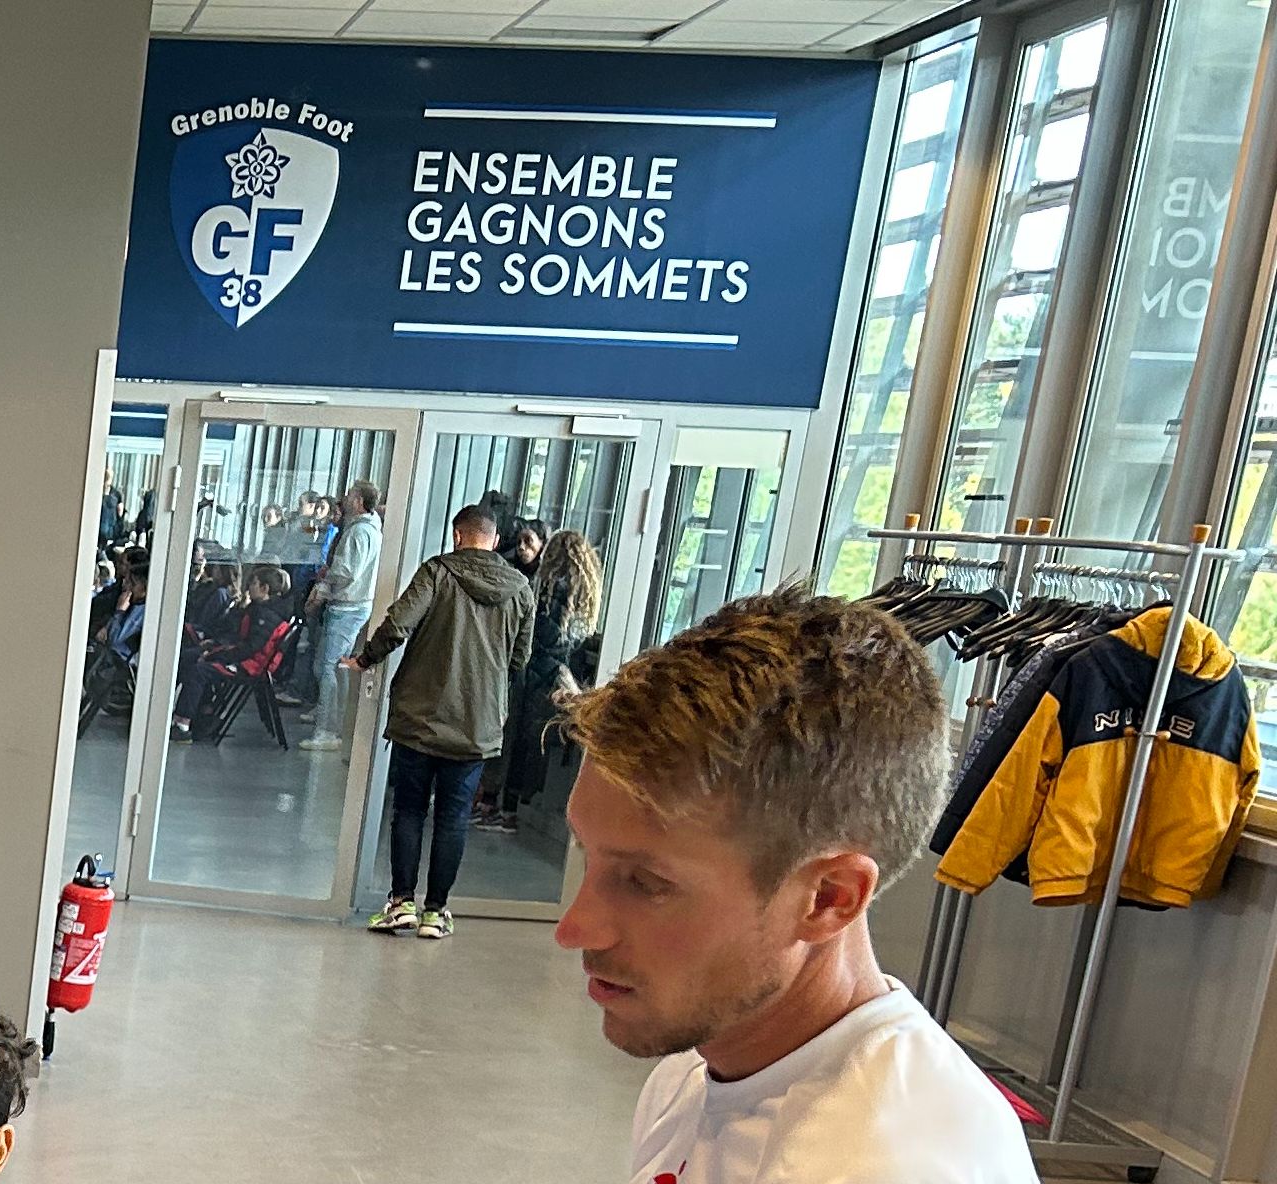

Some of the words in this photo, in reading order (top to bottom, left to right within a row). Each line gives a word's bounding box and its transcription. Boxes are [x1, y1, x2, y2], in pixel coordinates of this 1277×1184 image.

[171, 98, 290, 136] Grenoble
[298, 103, 354, 142] Foot
[413, 151, 678, 200] ENSEMBLE
[191, 204, 303, 276] GF
[407, 201, 666, 250] GAGNONS
[220, 277, 262, 308] 38
[399, 250, 482, 293] LES
[499, 252, 749, 303] SOMMETS
[1094, 706, 1196, 739] NIE
